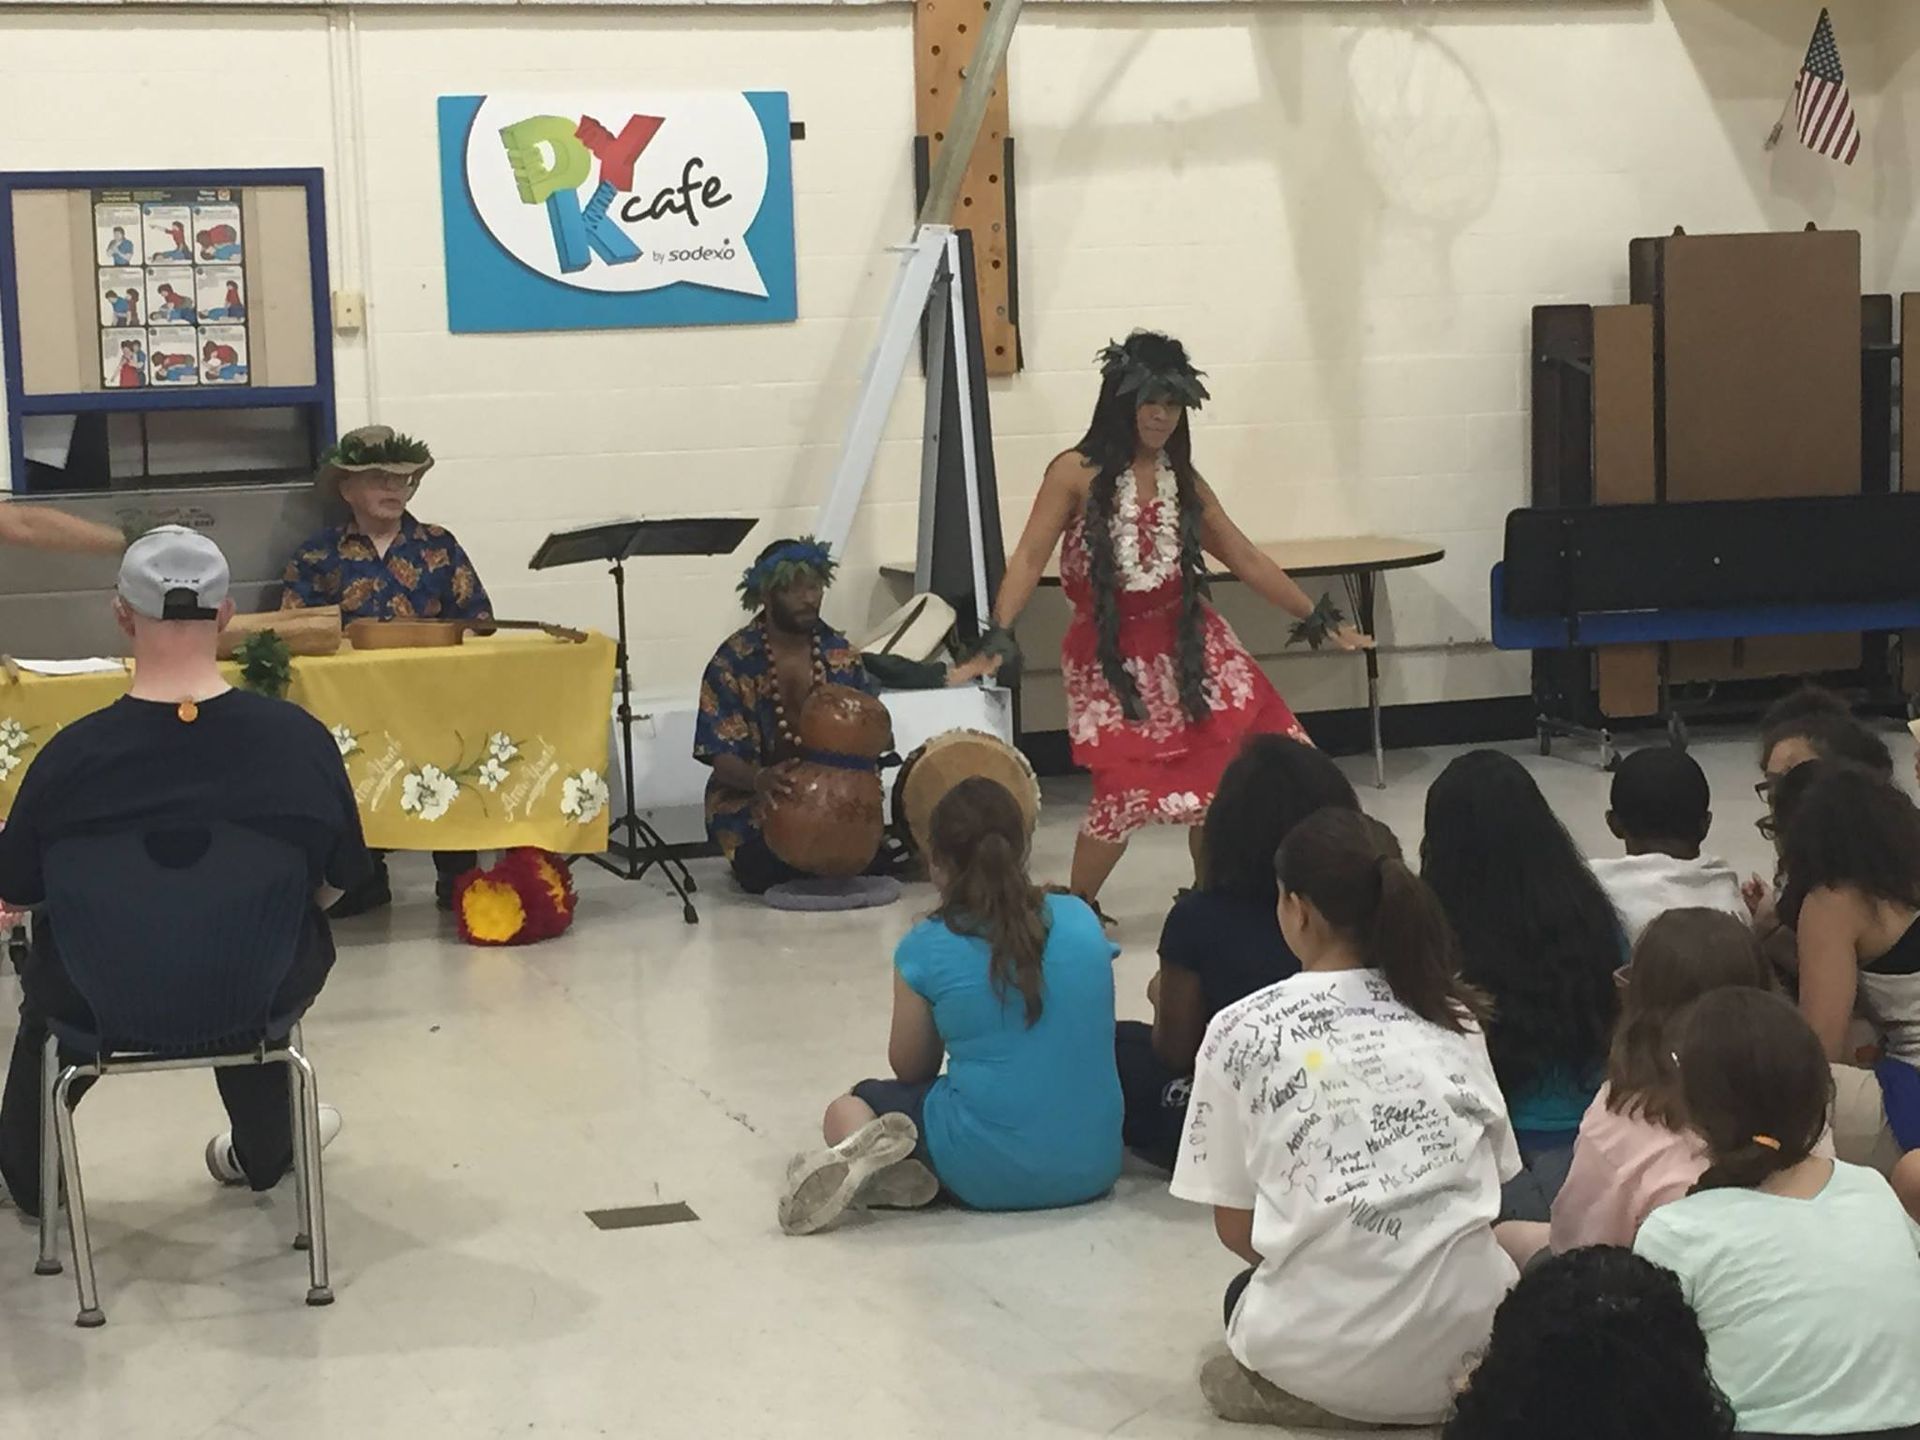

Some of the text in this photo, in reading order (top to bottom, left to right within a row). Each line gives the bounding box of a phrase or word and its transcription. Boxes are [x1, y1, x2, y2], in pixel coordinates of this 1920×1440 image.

[620, 157, 732, 226] cafe
[652, 238, 735, 264] by sodexo
